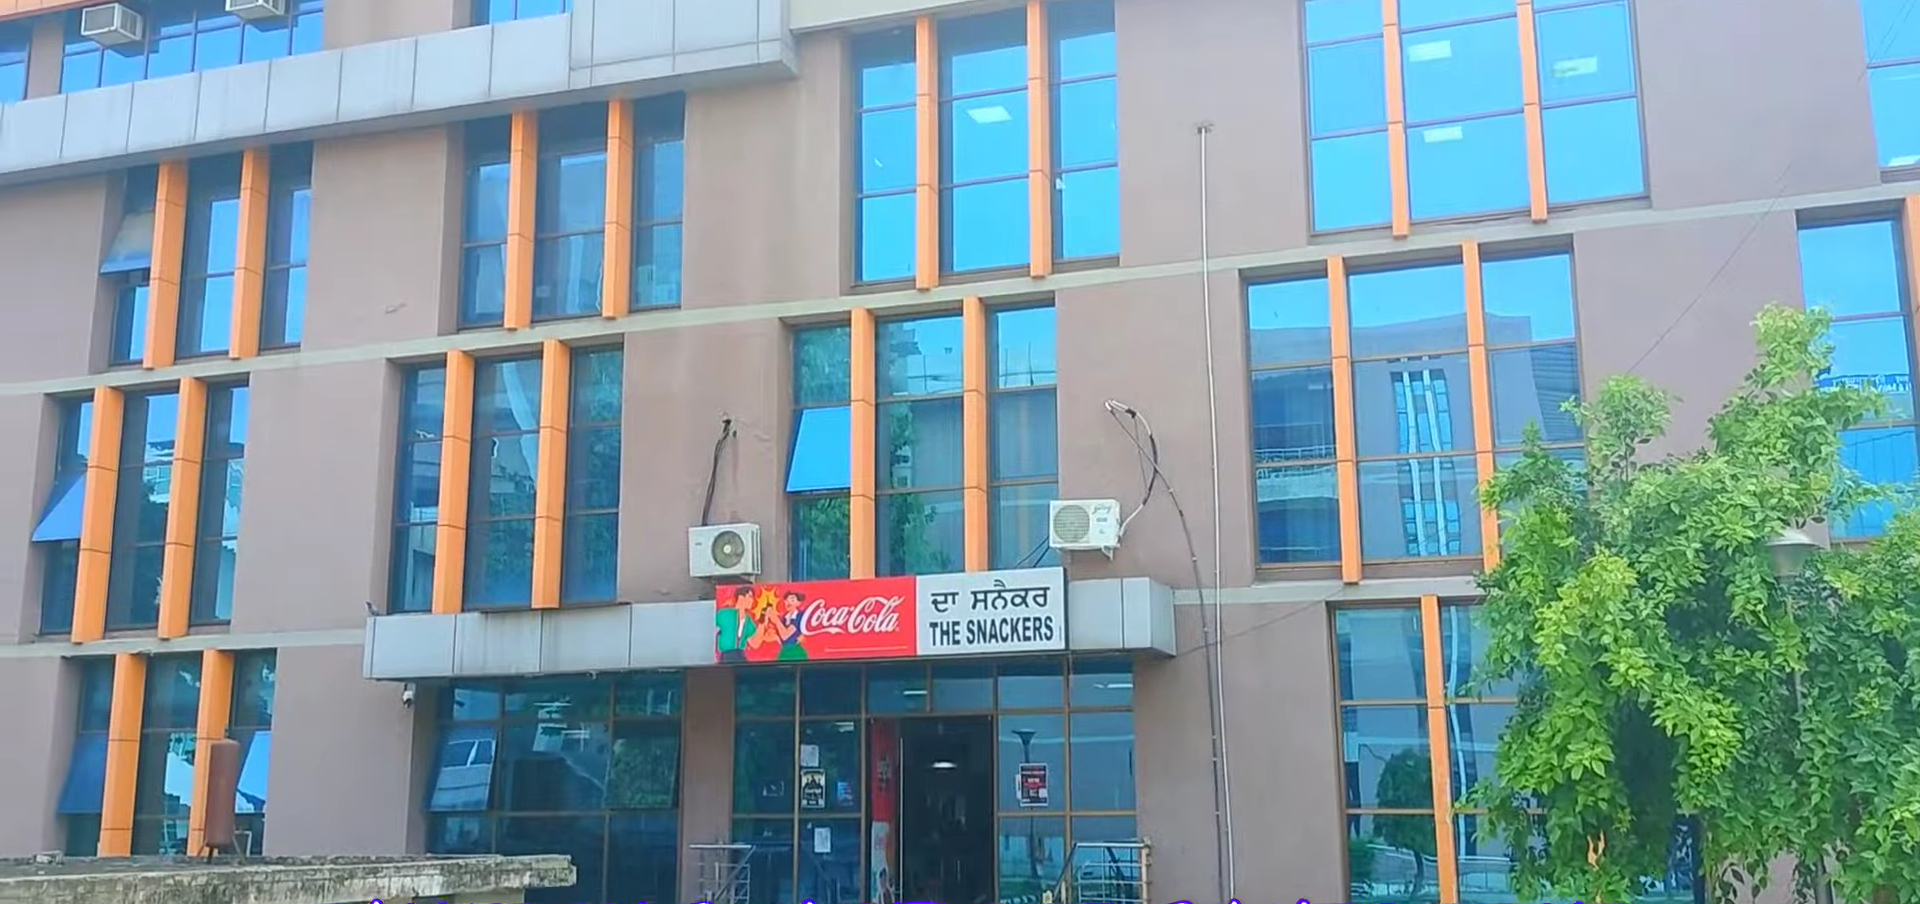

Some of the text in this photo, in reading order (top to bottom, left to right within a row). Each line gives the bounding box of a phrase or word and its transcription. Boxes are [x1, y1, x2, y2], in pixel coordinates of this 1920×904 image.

[930, 579, 1051, 613] ਦਾ ਸਨੈਕਰ
[800, 595, 906, 636] Coca-Cola
[929, 615, 1054, 647] THE SNACKERS
